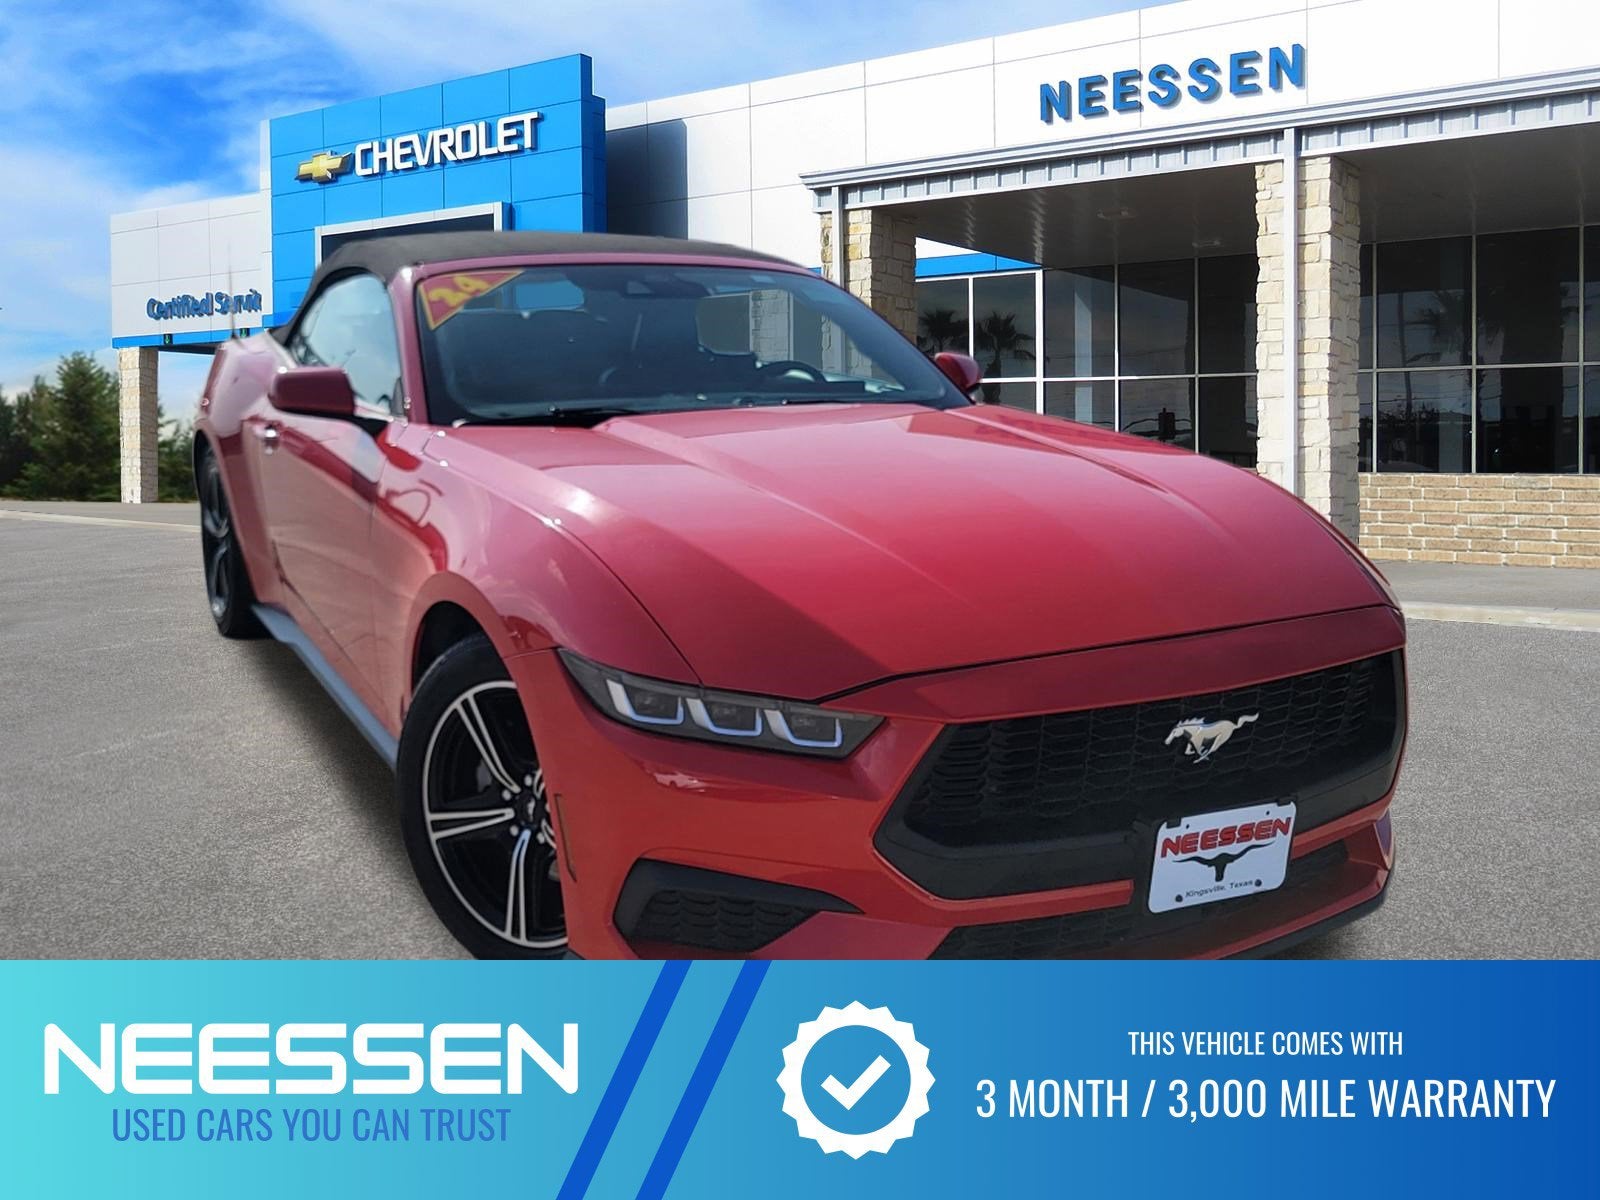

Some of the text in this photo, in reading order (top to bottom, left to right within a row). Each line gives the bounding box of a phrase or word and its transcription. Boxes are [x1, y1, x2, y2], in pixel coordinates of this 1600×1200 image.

[1040, 43, 1306, 124] NEESSEN
[354, 111, 543, 178] CHEVROLET
[146, 292, 213, 320] Certified
[1161, 816, 1292, 858] NEESSEN
[1230, 880, 1253, 889] Texas
